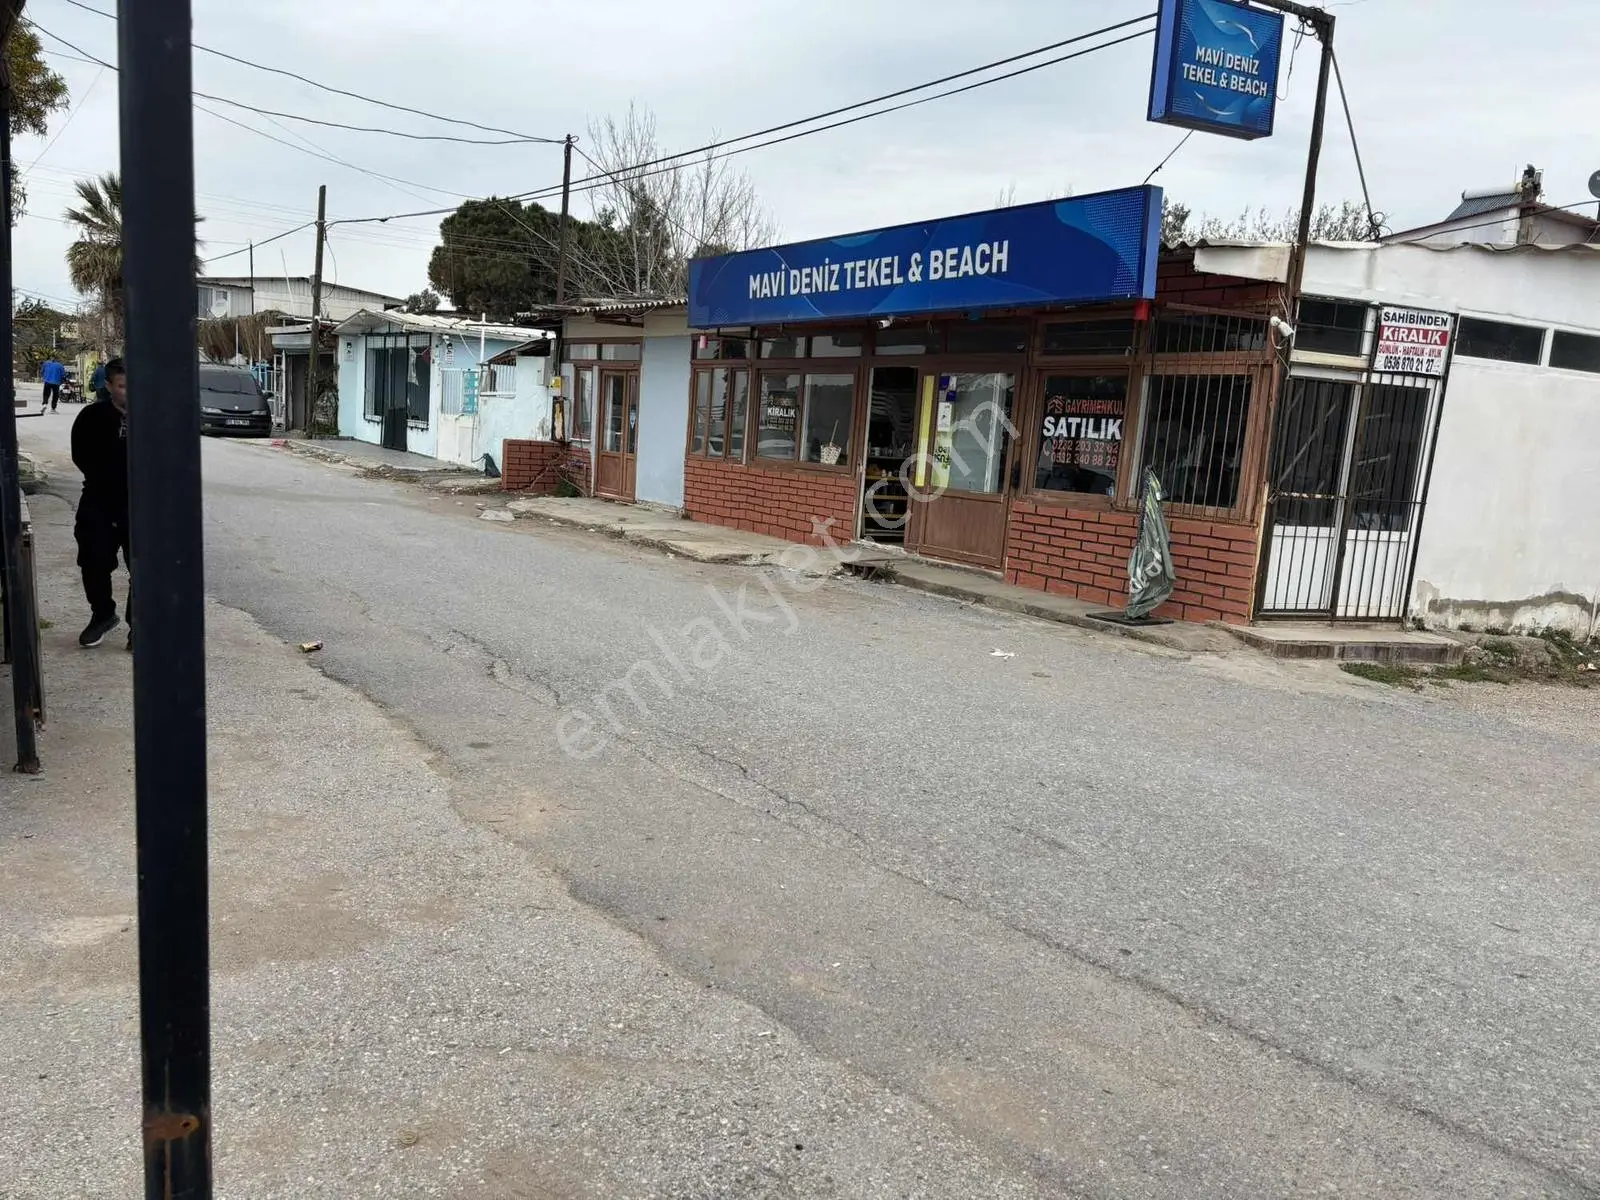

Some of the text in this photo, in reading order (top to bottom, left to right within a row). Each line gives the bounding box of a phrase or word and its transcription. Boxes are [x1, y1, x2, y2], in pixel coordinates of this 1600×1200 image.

[1196, 45, 1260, 75] MAVİ DENİZ
[1182, 63, 1268, 97] TEKEL & BEACH
[749, 240, 1009, 299] MAVİ DENİZ TEKEL & BEACH
[1383, 311, 1448, 327] SAHİBİNDEN
[1043, 416, 1122, 440] SATILIK
